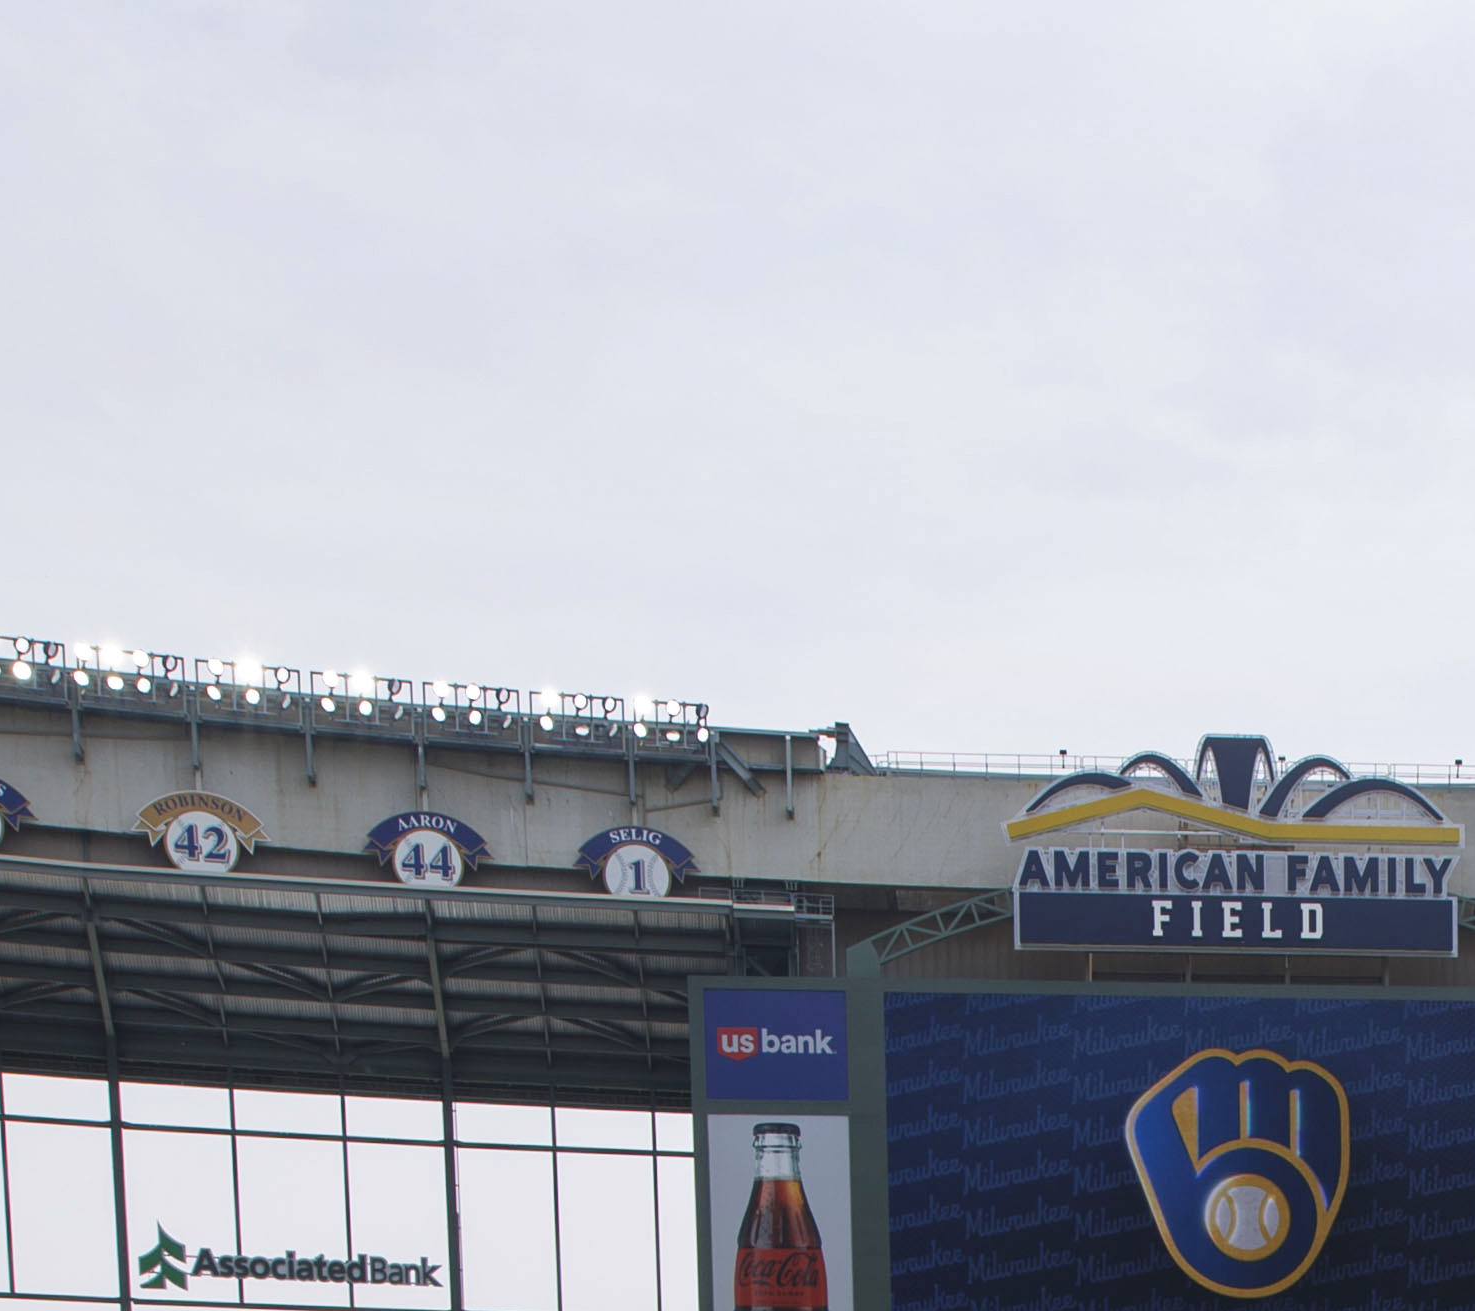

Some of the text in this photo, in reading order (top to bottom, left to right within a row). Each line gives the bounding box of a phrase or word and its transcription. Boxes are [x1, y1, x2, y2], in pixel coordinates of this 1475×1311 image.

[152, 793, 245, 823] ROBINSON
[397, 814, 458, 834] AARON
[175, 823, 230, 864] 42
[610, 825, 663, 848] SELIG
[401, 842, 455, 881] 44
[627, 859, 649, 893] 1
[1019, 848, 1454, 897] AMERICAN FAMILY
[1152, 900, 1324, 940] FIELD
[760, 1027, 834, 1056] bank
[738, 1251, 820, 1288] Coca-Cola
